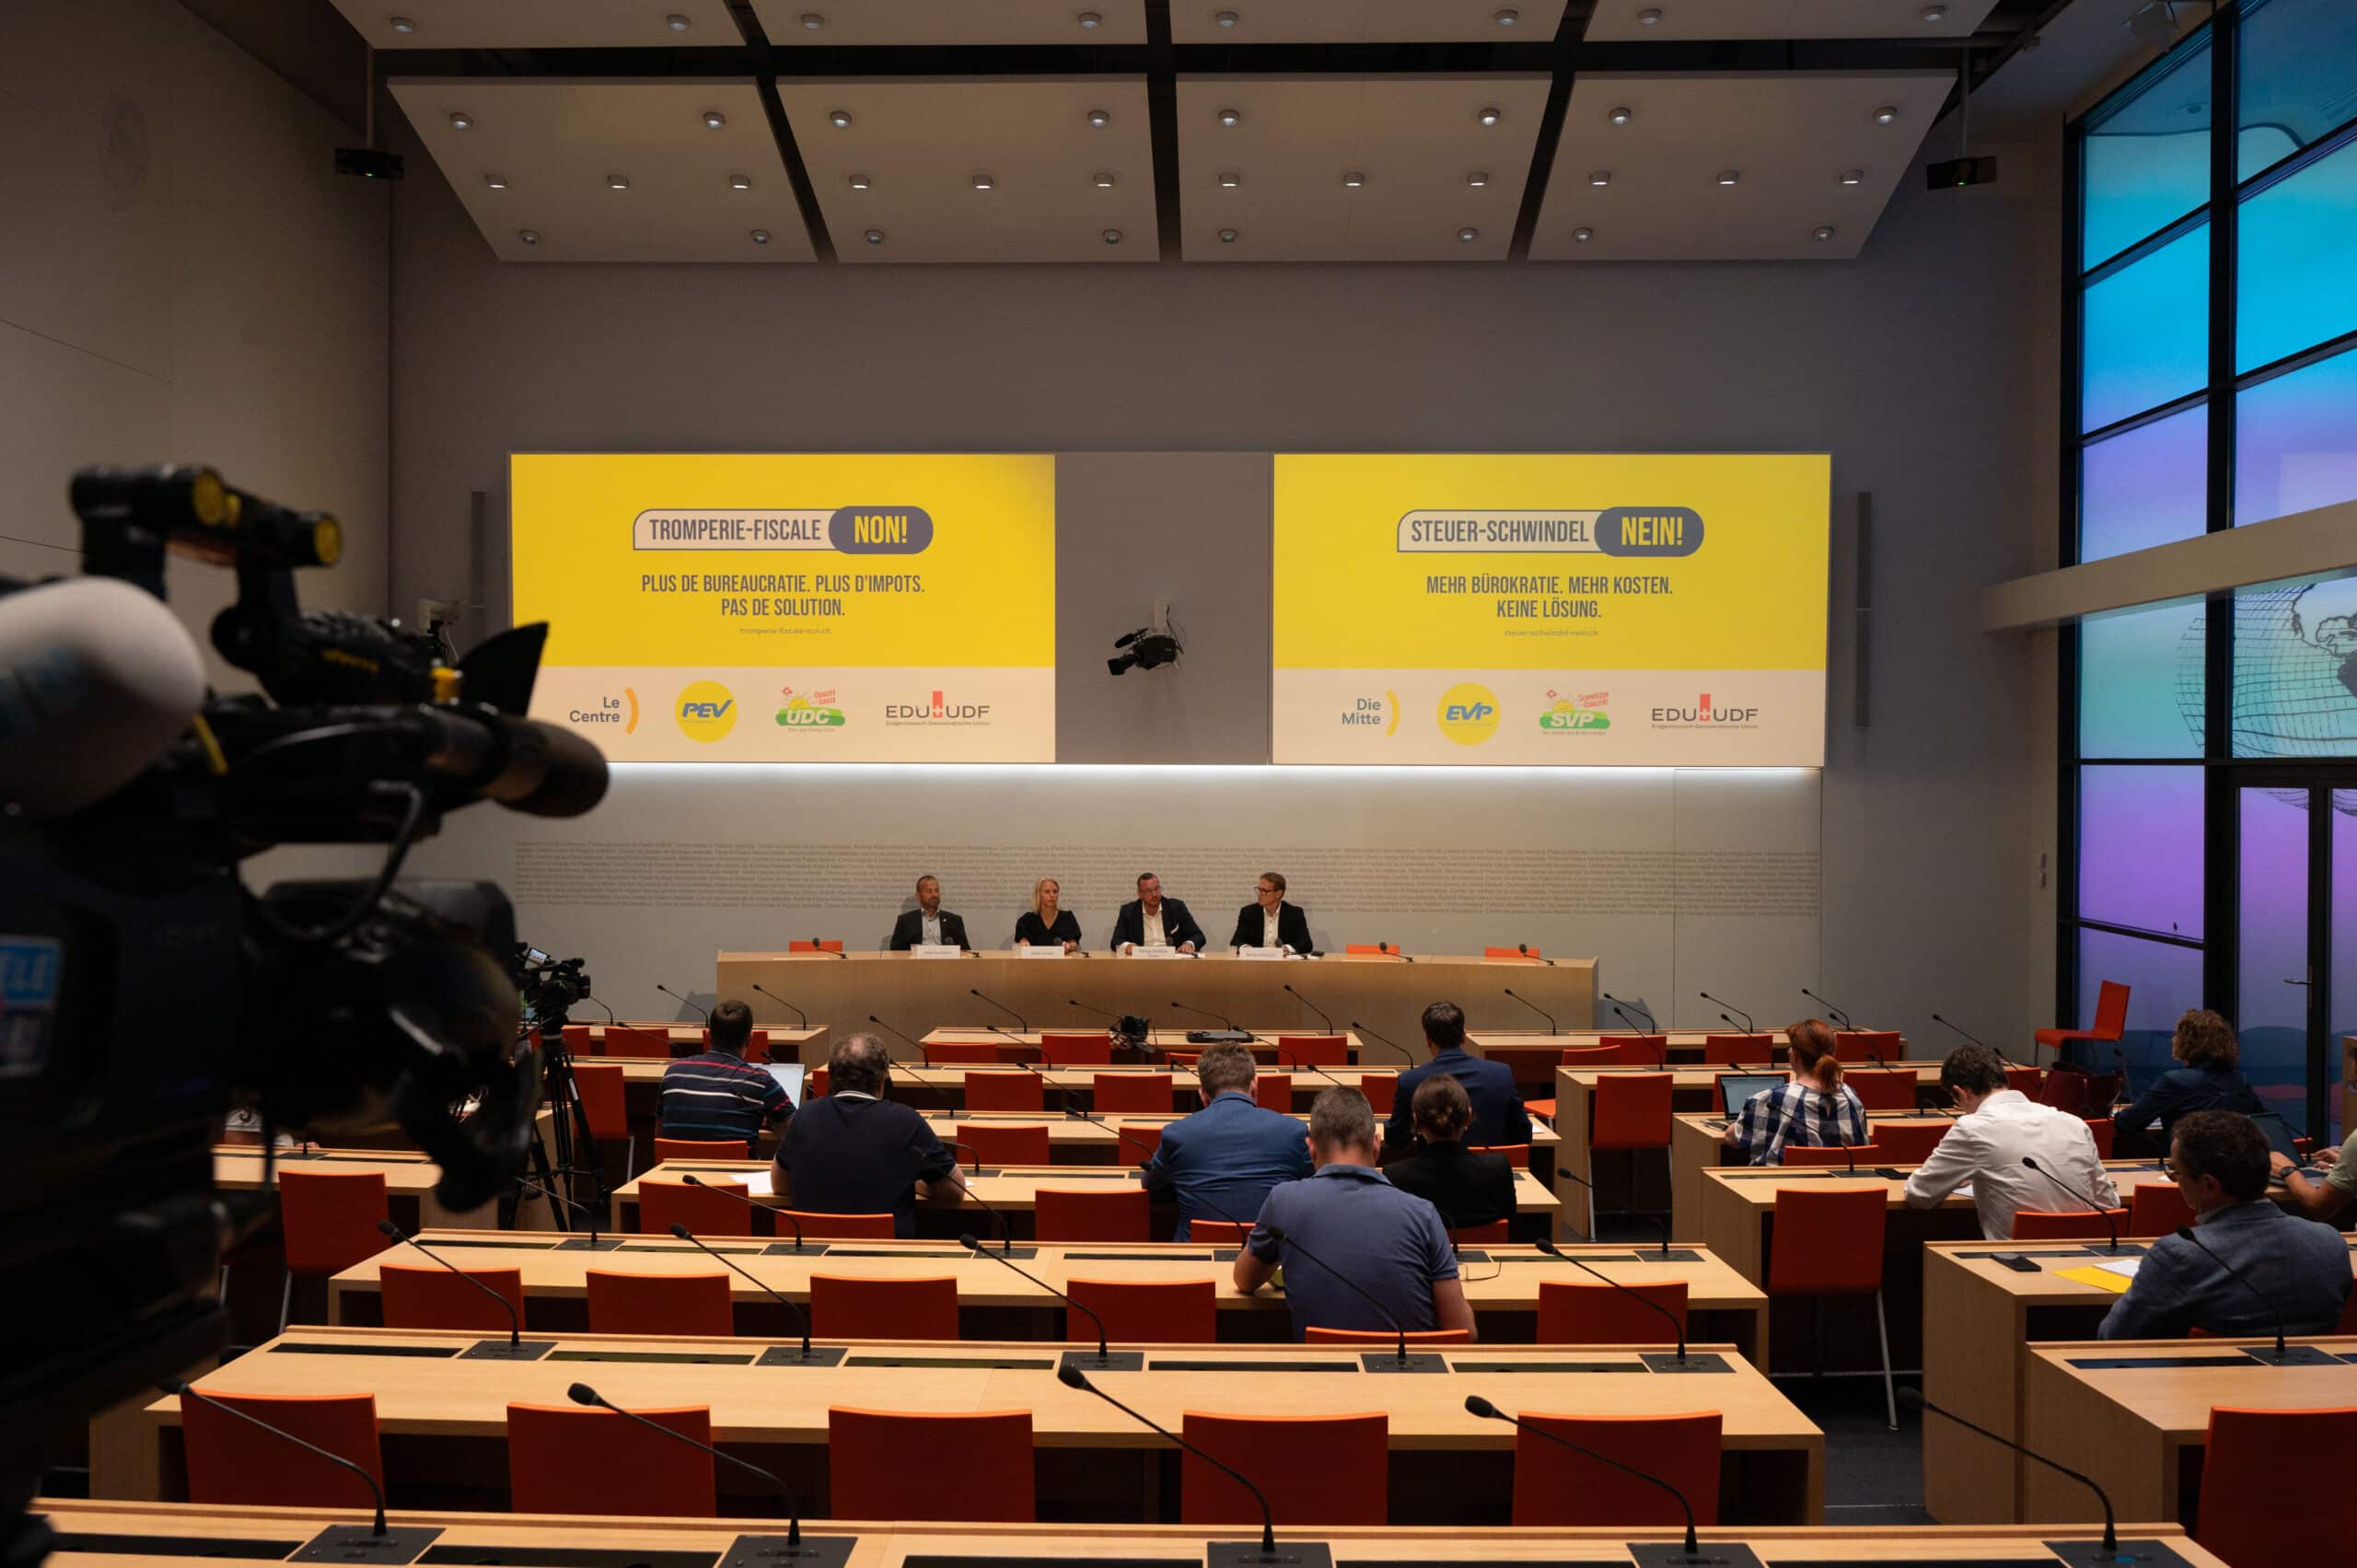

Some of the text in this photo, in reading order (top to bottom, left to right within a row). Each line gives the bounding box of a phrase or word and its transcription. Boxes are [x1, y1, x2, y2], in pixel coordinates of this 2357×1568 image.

[648, 515, 908, 544] TROMPERIE-FISCALE NON!
[1411, 516, 1683, 546] STEUER-SCHWINDEL NEIN!
[641, 574, 925, 593] PLUS DE BUREAUCRATIE. PLUS D'IMPOTS.
[1426, 573, 1673, 595] MEHR BÜROKRATIE. MEHR KOSTEN.
[721, 598, 845, 617] PAS DE SOLUTION.
[1496, 596, 1602, 619] KEINE LÖSUNG.
[603, 696, 620, 709] Le
[681, 699, 733, 719] PEV
[1356, 698, 1381, 712] Die
[569, 710, 621, 723] Centre
[786, 709, 830, 724] UDC
[886, 705, 991, 719] EDU UDF
[1341, 712, 1381, 726] Mitte
[1446, 702, 1493, 721] EVP
[1550, 712, 1594, 728] SVP
[1652, 708, 1759, 722] EDU UDF
